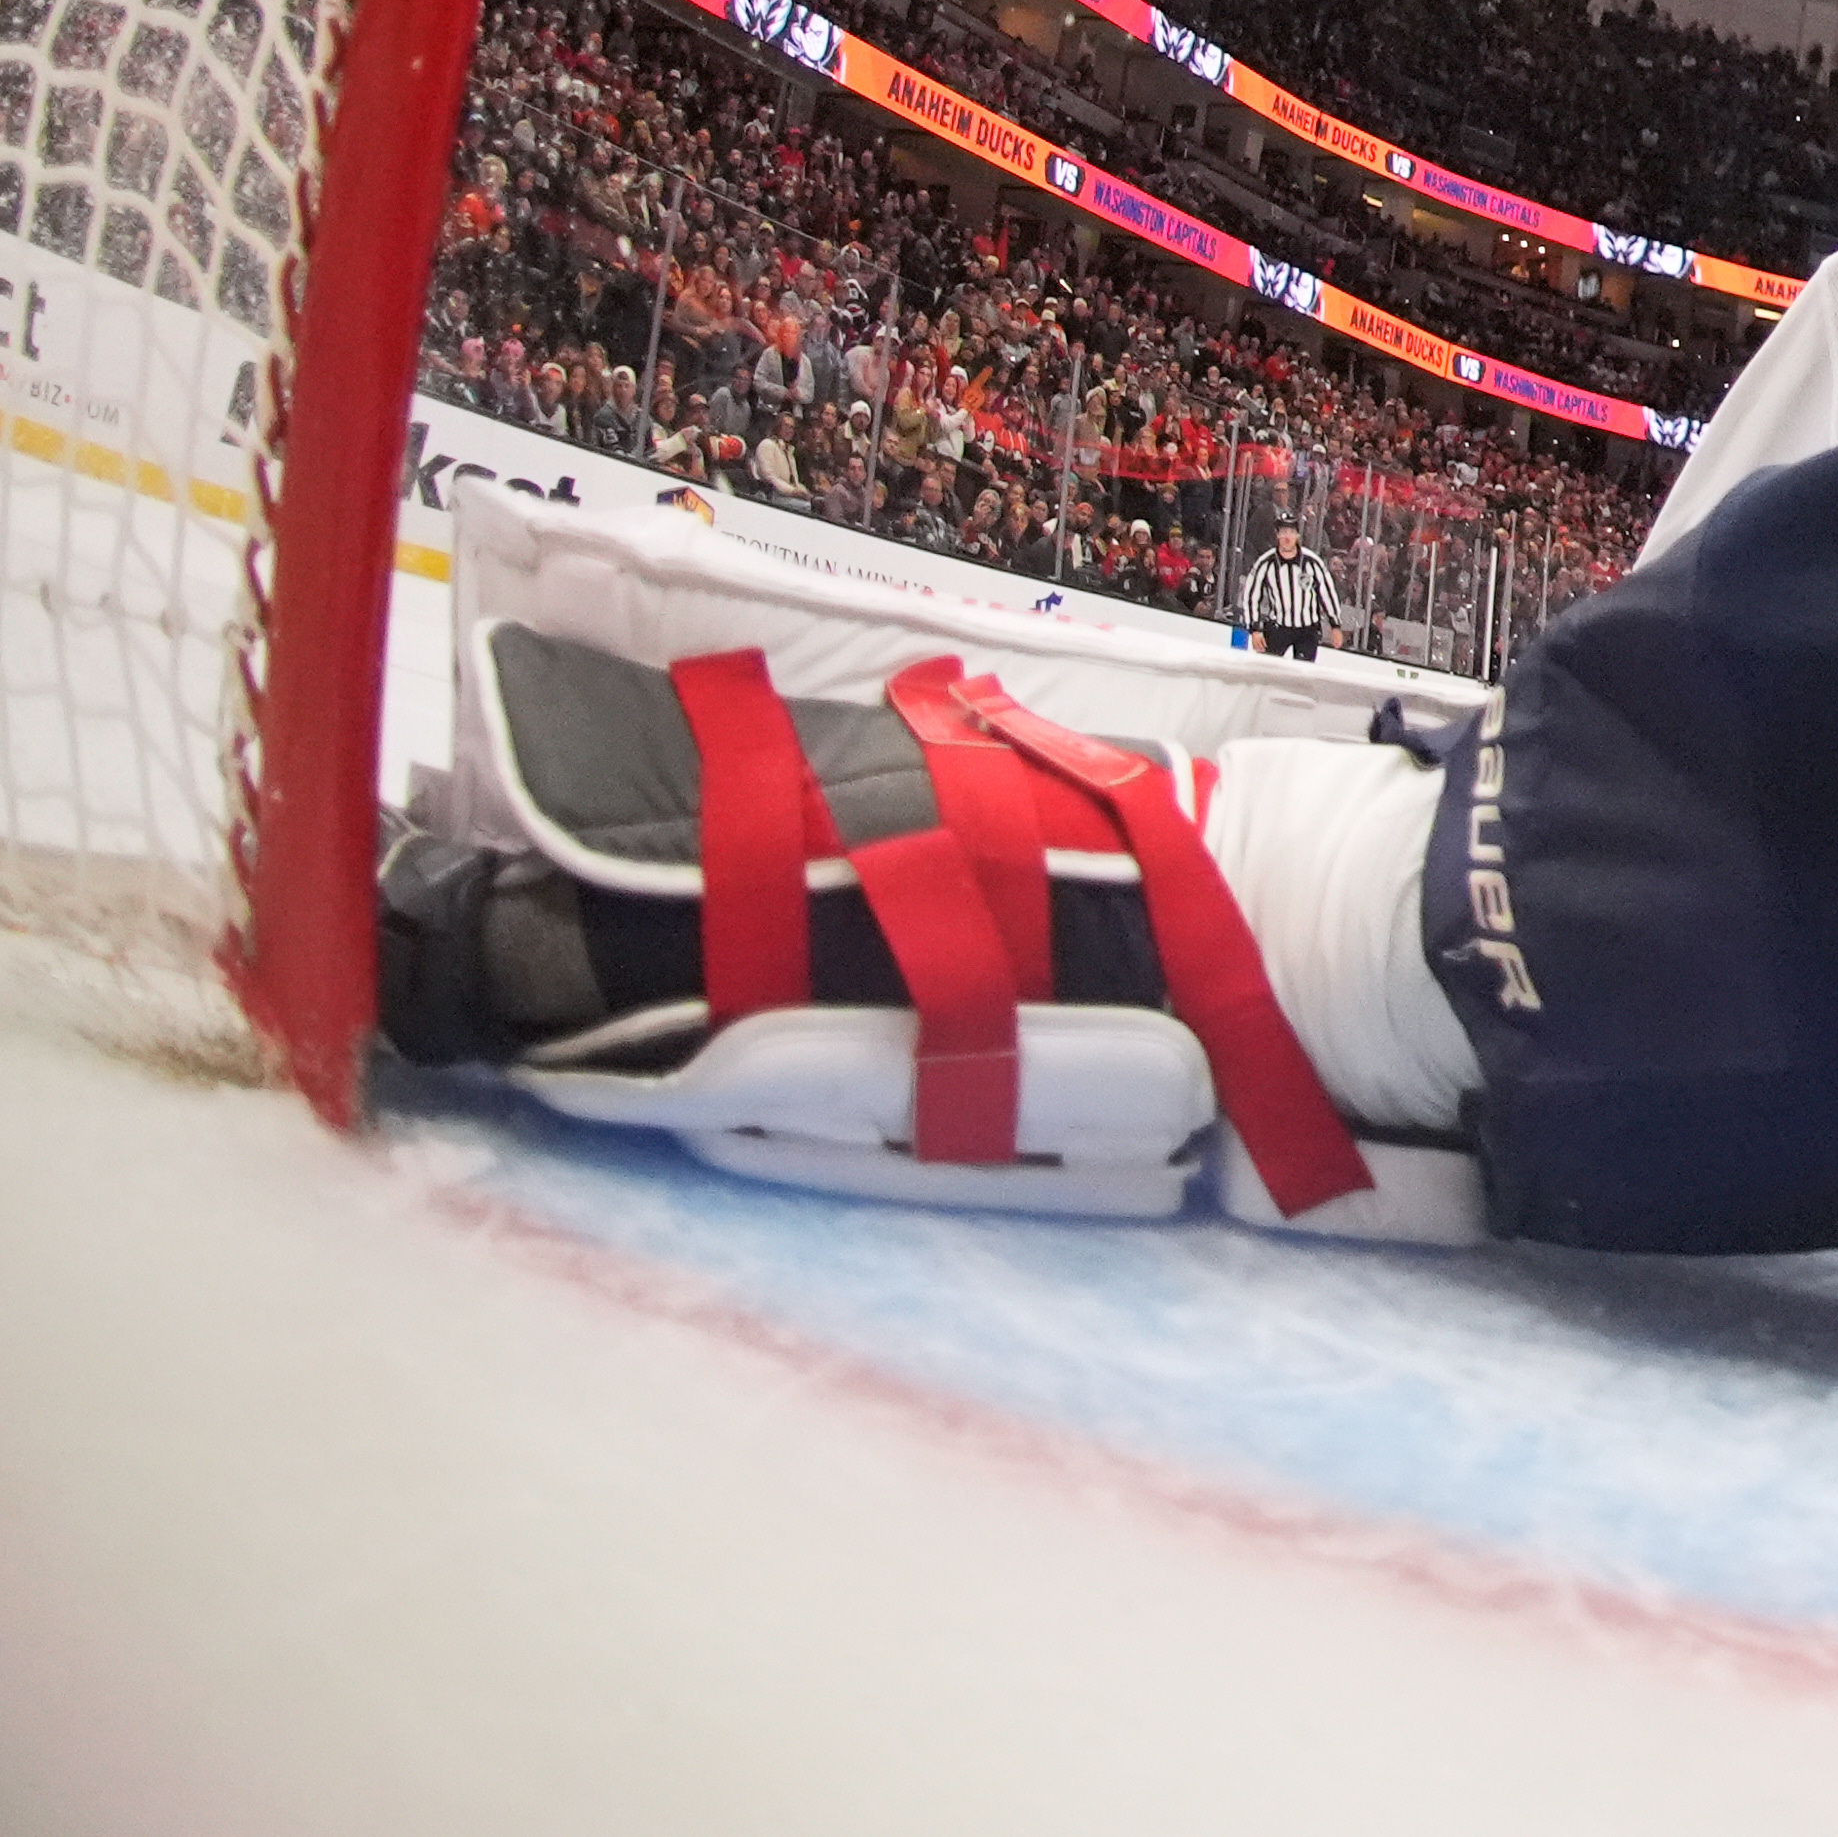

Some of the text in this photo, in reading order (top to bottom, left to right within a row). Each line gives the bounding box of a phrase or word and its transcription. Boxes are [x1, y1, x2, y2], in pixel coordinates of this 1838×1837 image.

[887, 71, 974, 138] ANAHEIM
[975, 116, 1037, 171] DUCKS
[1054, 157, 1079, 194] VS
[1271, 92, 1330, 142] ANAHEIM
[1331, 125, 1379, 164] DUCKS
[1391, 154, 1412, 178] VS
[1350, 305, 1402, 351] ANAHEIM
[1404, 330, 1445, 369] DUCKS
[1459, 355, 1482, 382] VS
